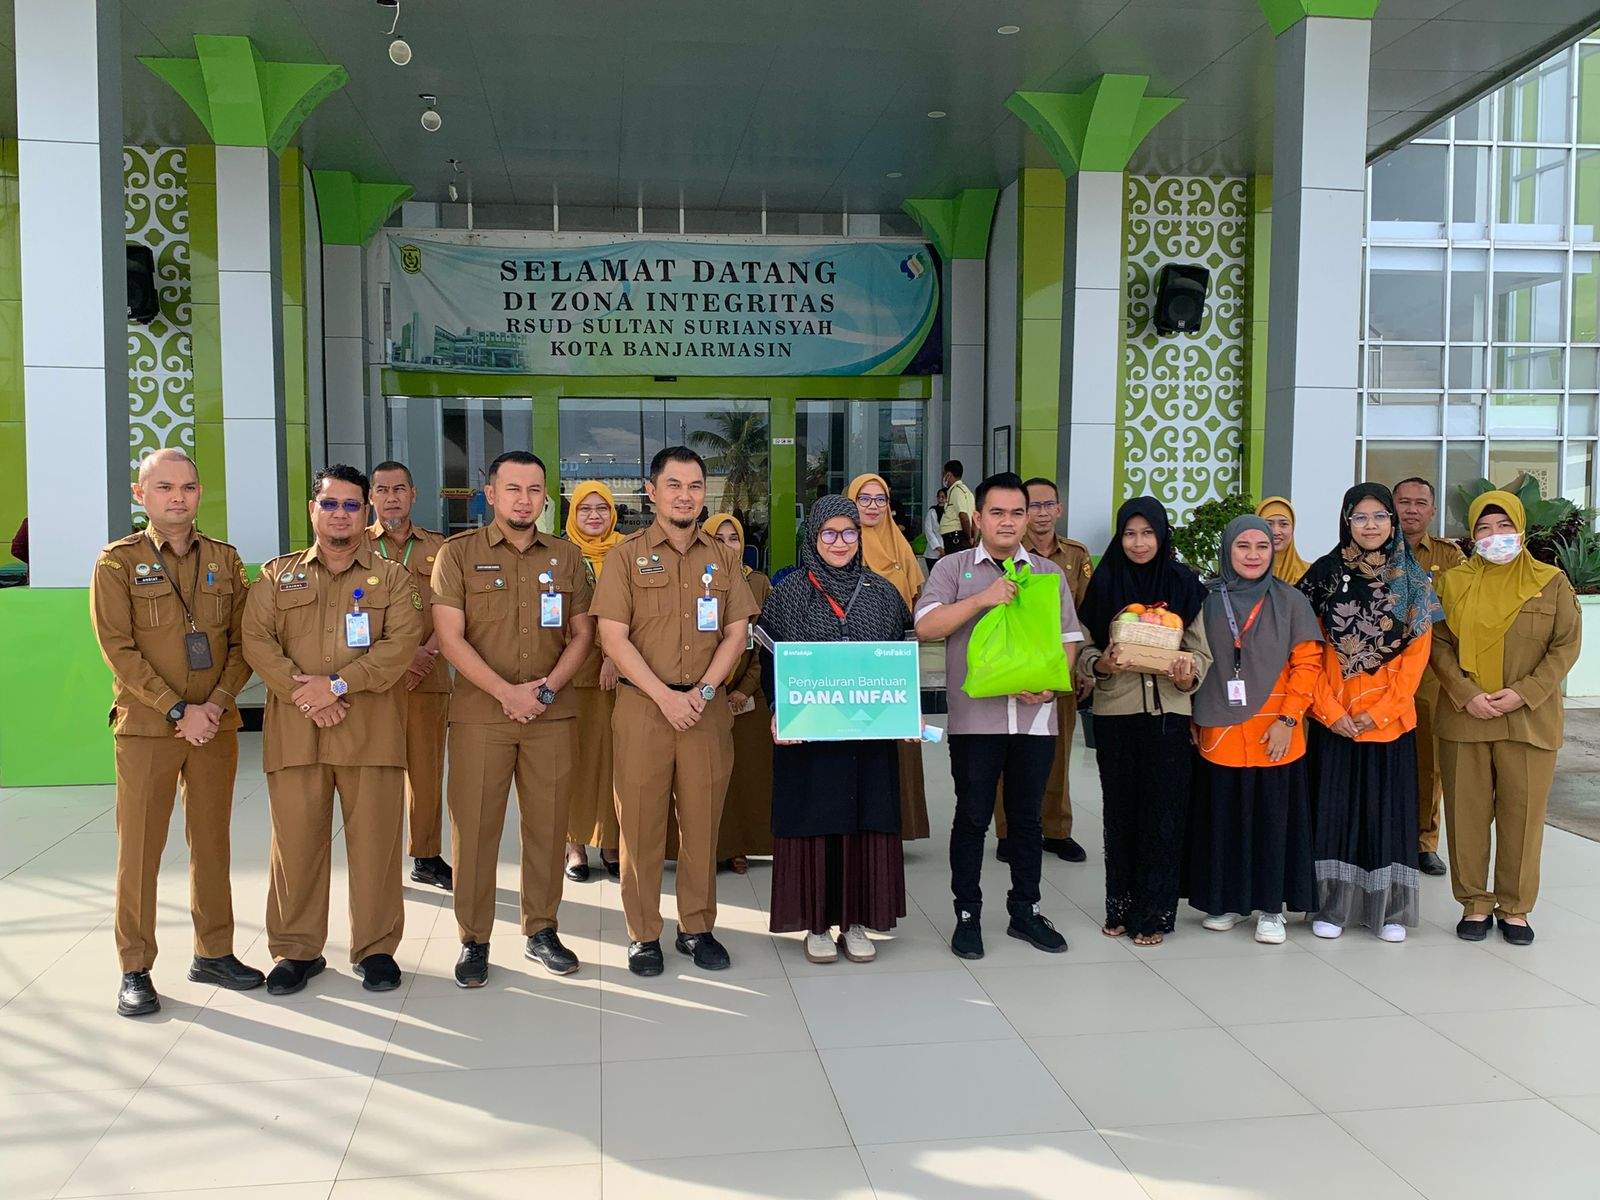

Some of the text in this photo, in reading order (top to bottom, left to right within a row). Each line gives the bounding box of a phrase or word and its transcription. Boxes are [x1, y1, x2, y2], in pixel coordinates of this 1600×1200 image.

[500, 259, 837, 284] SELAMAT DATANG
[503, 291, 835, 313] DI ZONA INTEGRITAS
[506, 317, 833, 335] RSUD SULTAN SURIANSYAH
[550, 341, 792, 358] KOTA BANJARMASIN
[788, 676, 907, 690] Penyaluran Bantuan
[789, 689, 908, 705] DANA INFAK
